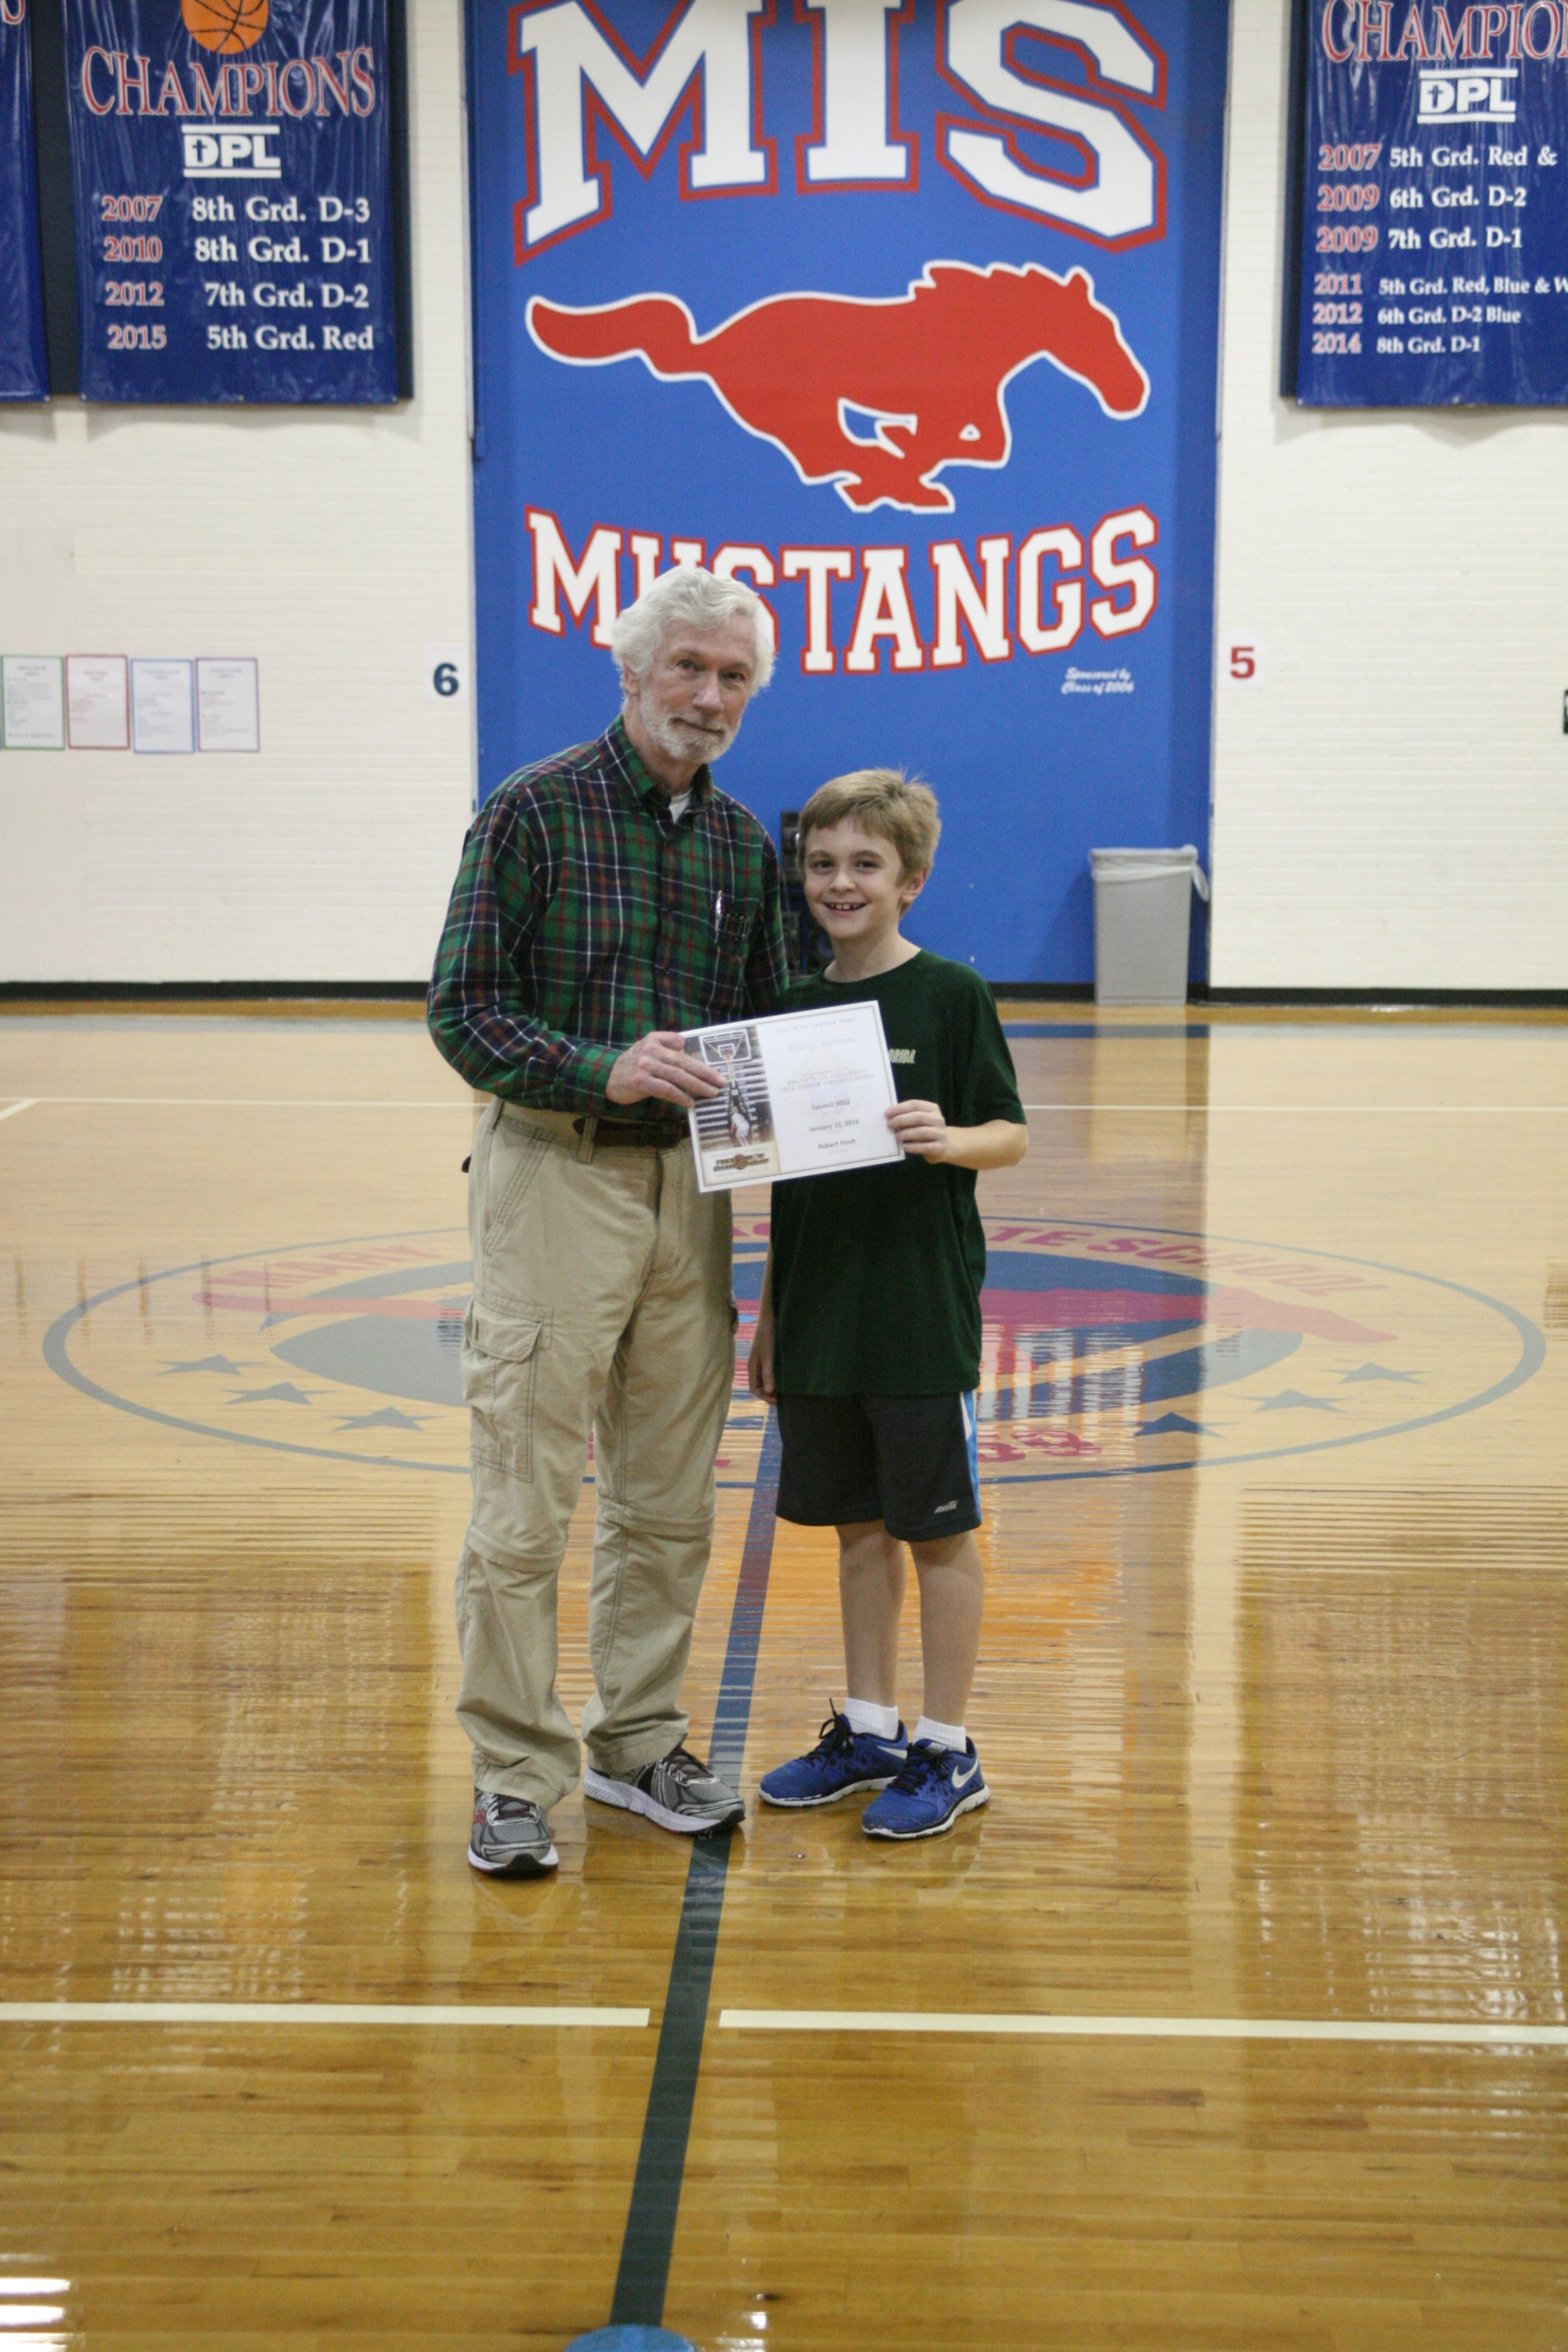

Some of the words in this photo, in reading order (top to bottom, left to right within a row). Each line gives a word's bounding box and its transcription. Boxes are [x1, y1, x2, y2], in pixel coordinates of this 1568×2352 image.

[81, 46, 376, 117] CHAMPIONS
[1419, 78, 1516, 113] DPL
[508, 0, 1168, 266] MIS
[184, 135, 281, 168] DPL
[1318, 144, 1381, 171] 2007
[1390, 148, 1423, 167] 5th
[1432, 148, 1478, 166] Grd.
[1488, 146, 1527, 166] Red
[1537, 147, 1557, 166] &
[102, 196, 162, 222] 2007
[192, 195, 234, 222] 8th
[246, 196, 306, 222] Grd.
[319, 198, 371, 222] D-3
[1318, 185, 1379, 211] 2009
[1390, 188, 1423, 208] 6th
[1432, 188, 1479, 207] Grd.
[1488, 188, 1527, 207] D-2
[103, 236, 162, 263] 2010
[194, 236, 237, 262] 8th
[248, 237, 309, 263] Grd.
[322, 238, 371, 262] D-1
[1316, 226, 1378, 253] 2009
[1388, 229, 1421, 249] 7th
[1429, 229, 1476, 248] Grd.
[1486, 229, 1523, 248] D-1
[106, 282, 165, 306] 2012
[205, 283, 245, 307] 7th
[254, 283, 313, 308] Grd.
[322, 283, 369, 308] D-2
[1315, 273, 1363, 296] 2011
[1379, 279, 1406, 296] 5th
[1410, 278, 1448, 296] Grd.
[1452, 277, 1490, 296] Red,
[1494, 276, 1530, 294] Blue
[1534, 276, 1550, 294] &
[1312, 302, 1363, 325] 2012
[1378, 308, 1406, 325] 6th
[1409, 308, 1447, 325] Grd.
[1452, 307, 1482, 324] D-2
[1486, 307, 1521, 324] Blue
[107, 325, 166, 350] 2015
[207, 325, 247, 350] 5th
[255, 325, 315, 350] Grd.
[322, 325, 374, 350] Red
[1312, 332, 1362, 354] 2014
[1377, 337, 1404, 354] 8th
[1408, 337, 1446, 354] Grd.
[1451, 337, 1481, 353] D-1
[1230, 646, 1256, 679] 5
[433, 663, 459, 697] 6
[812, 1101, 834, 1110] Council
[808, 1123, 832, 1132] January
[840, 1138, 857, 1146] Finch
[1086, 1236, 1389, 1297] SCHOOL
